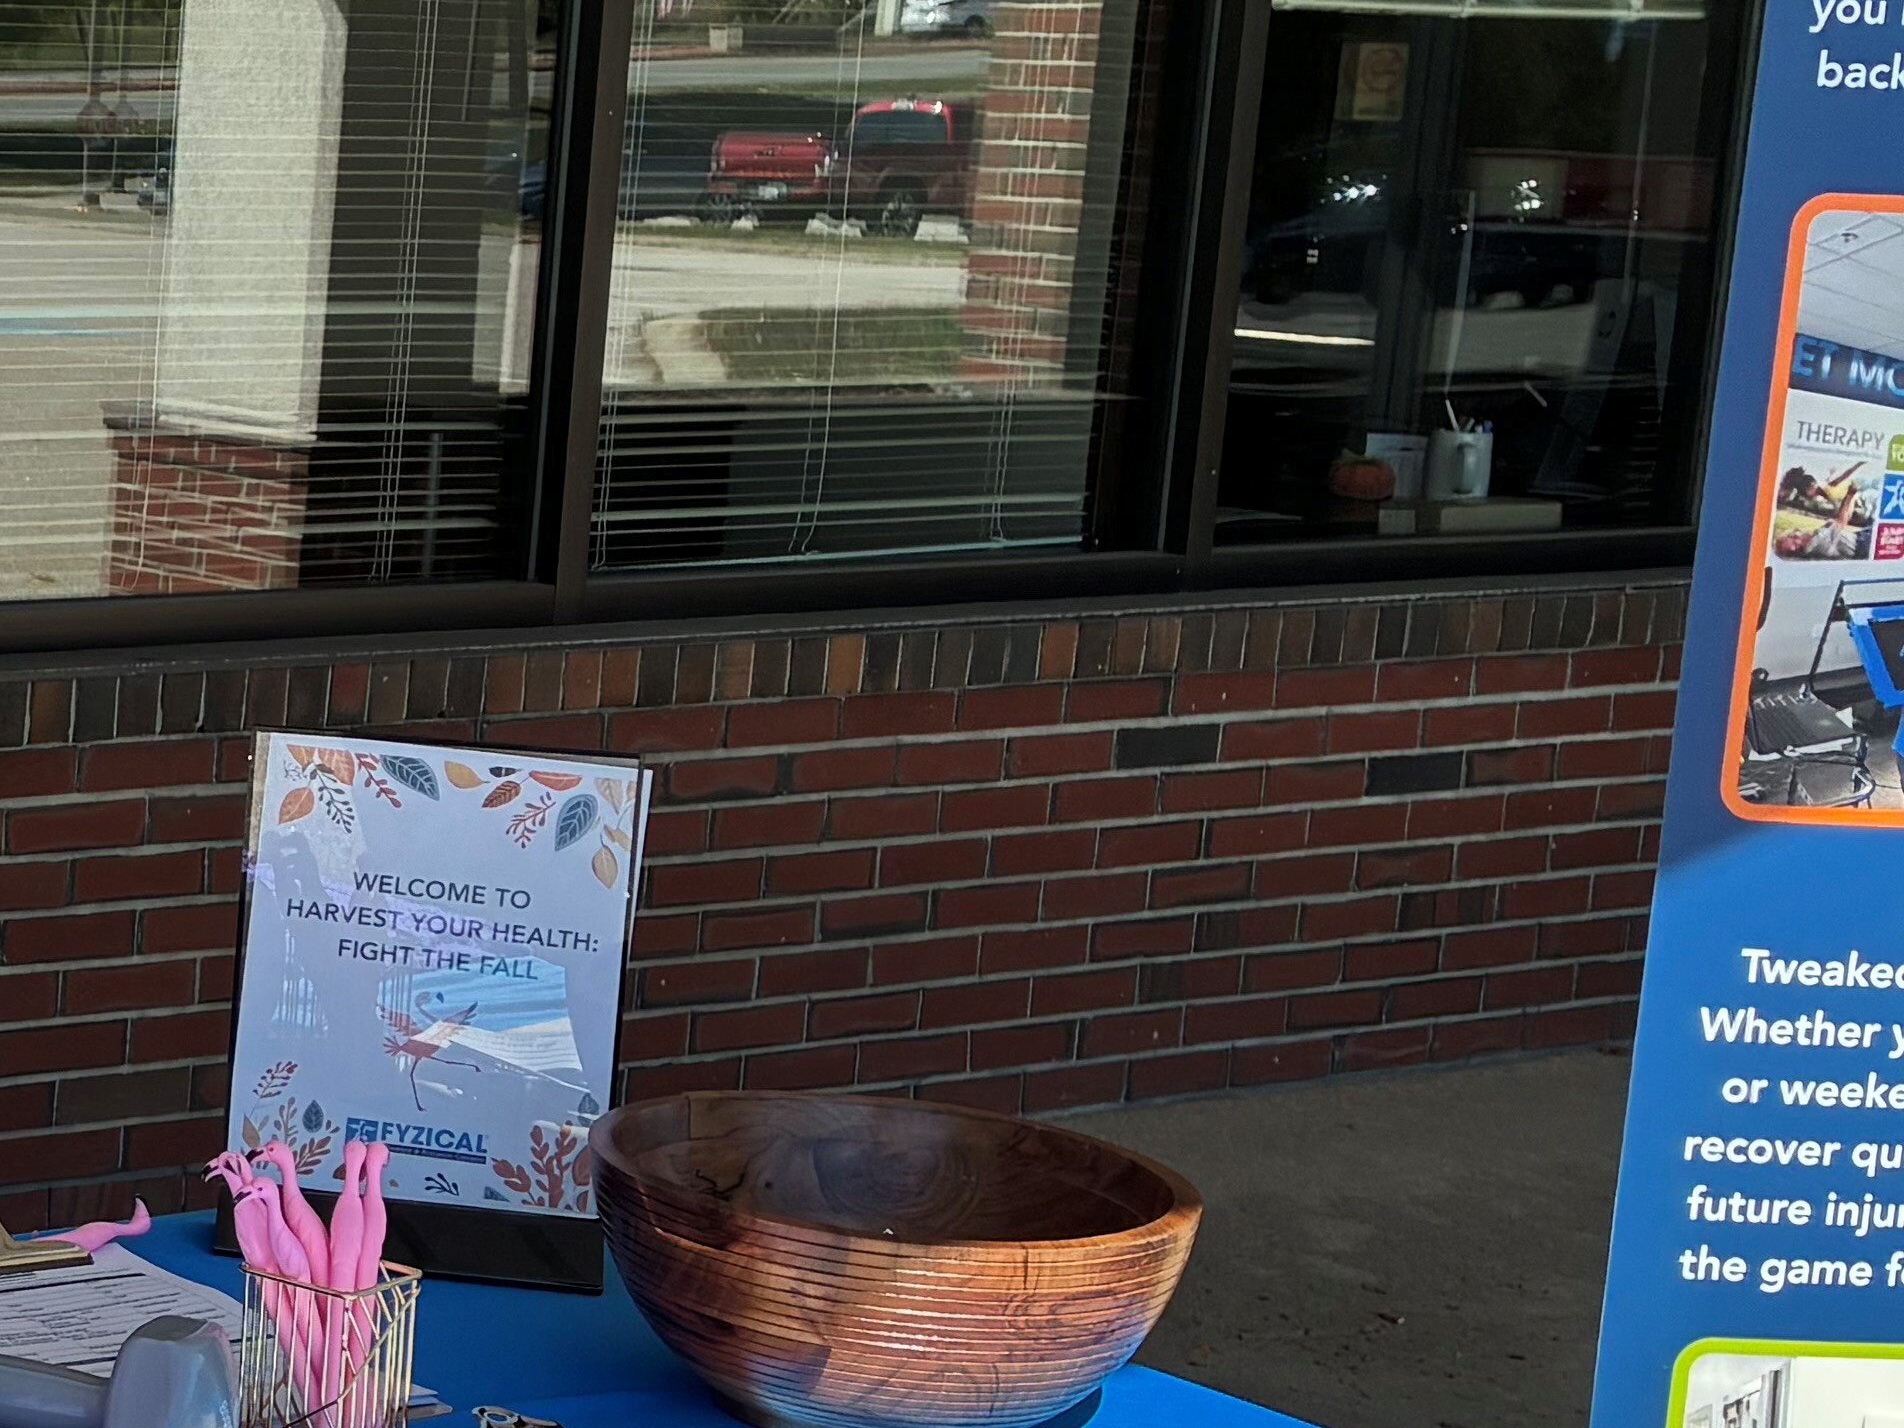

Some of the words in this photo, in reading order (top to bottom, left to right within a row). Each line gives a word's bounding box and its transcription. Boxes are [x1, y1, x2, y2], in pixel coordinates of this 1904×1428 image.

[1816, 49, 1904, 90] back
[1795, 420, 1885, 450] THERAPY
[353, 871, 487, 906] WELCOME
[496, 888, 532, 910] TO
[286, 898, 407, 930] HARVEST
[410, 912, 484, 941] YOUR
[491, 922, 600, 954] HEALTH:
[337, 938, 415, 966] FIGHT
[421, 947, 472, 973] THE
[479, 956, 540, 981] FALL
[1699, 1007, 1882, 1048] Whether
[1722, 1078, 1769, 1105] or
[380, 1122, 489, 1154] FYZICAL
[1683, 1135, 1842, 1167] recover
[1686, 1184, 1812, 1226] future
[1678, 1244, 1748, 1283] the
[1759, 1258, 1874, 1294] game
